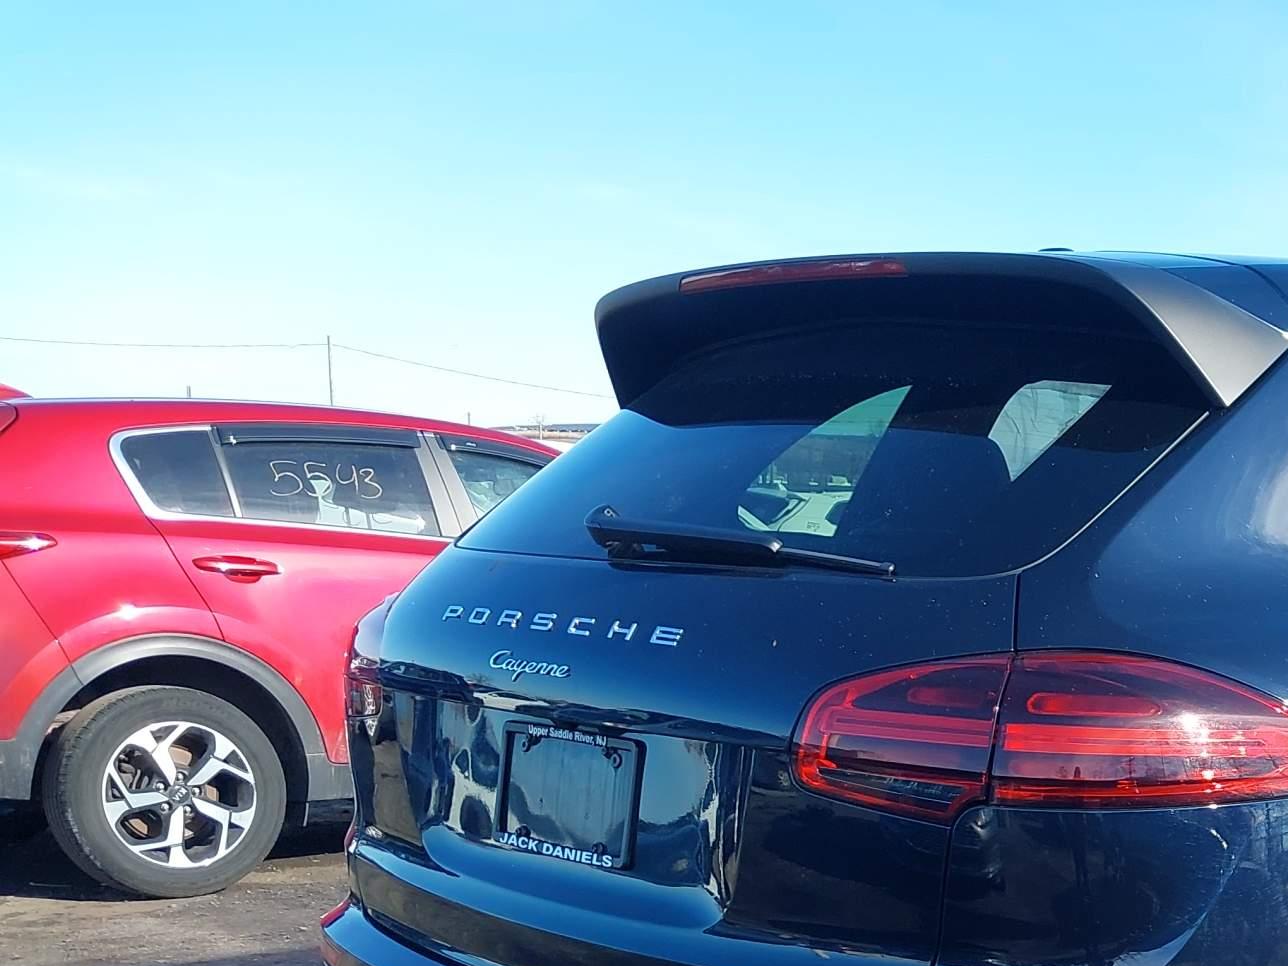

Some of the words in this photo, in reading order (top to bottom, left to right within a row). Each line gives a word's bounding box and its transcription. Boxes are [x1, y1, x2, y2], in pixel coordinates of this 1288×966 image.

[270, 460, 383, 499] 5543
[442, 605, 684, 646] PORSCHE
[490, 650, 569, 682] Cayenne
[528, 724, 549, 737] Upper
[549, 727, 573, 740] Saddle
[574, 731, 595, 746] River,
[596, 735, 607, 746] NJ
[500, 833, 538, 853] JACK
[542, 842, 613, 867] DANIELS
